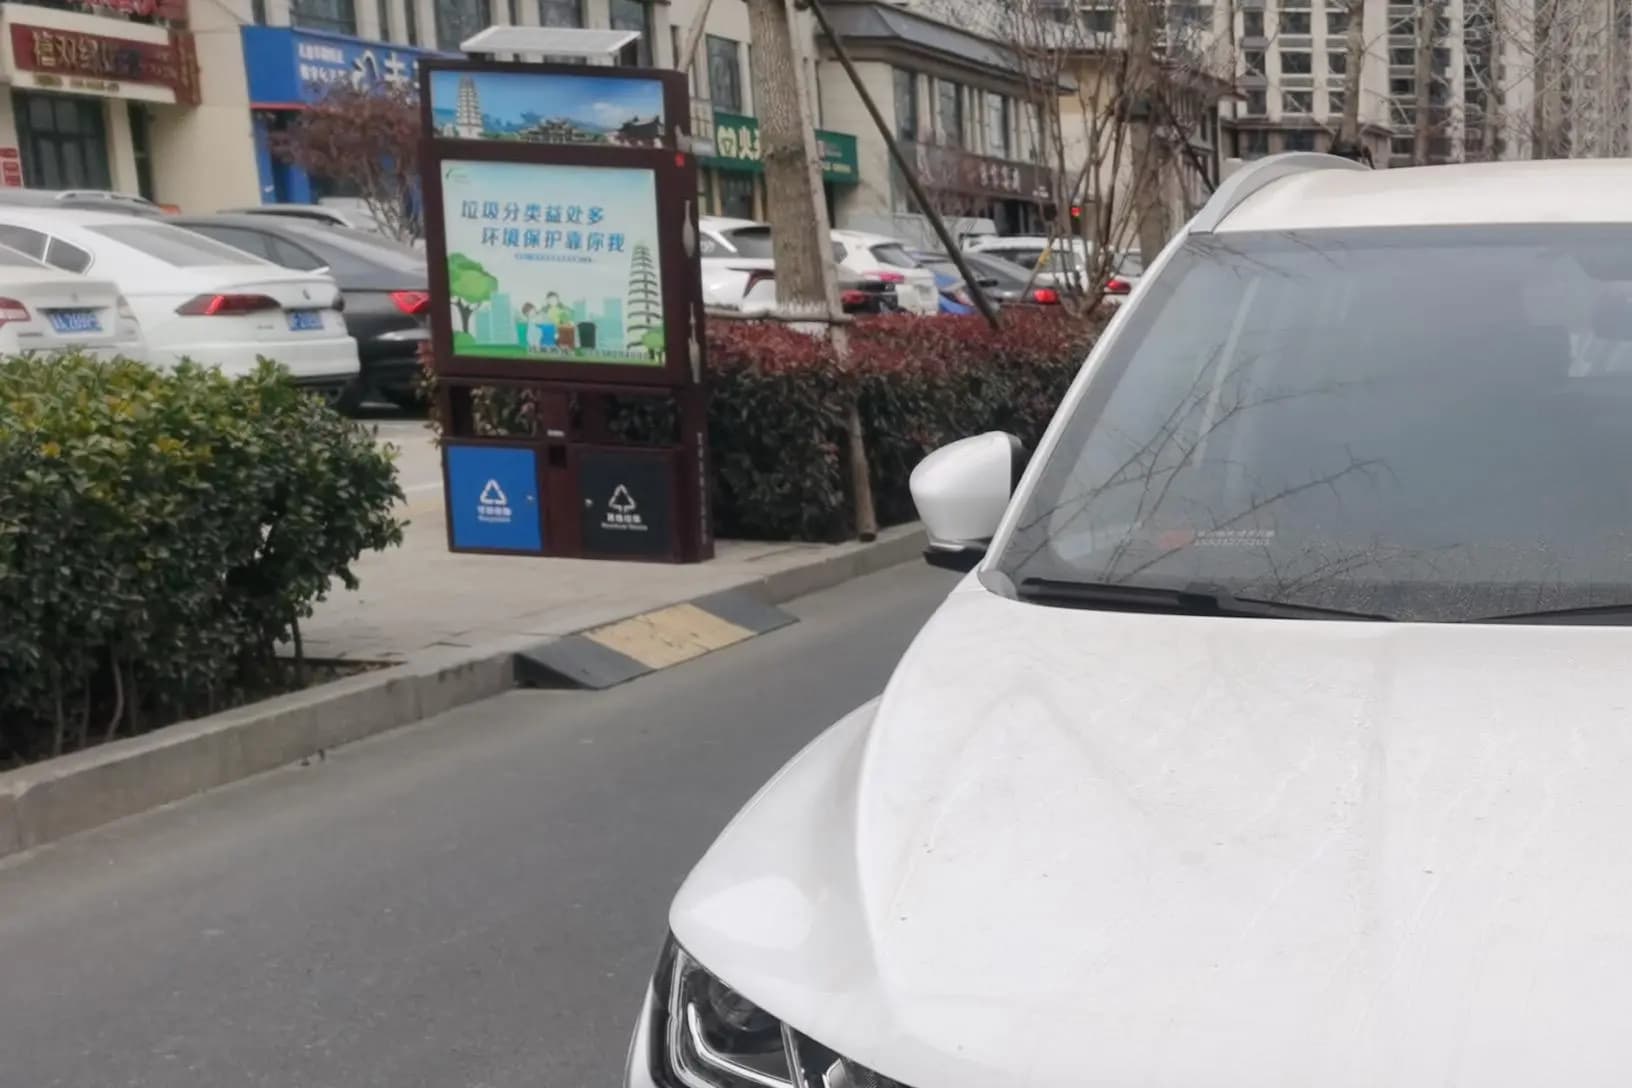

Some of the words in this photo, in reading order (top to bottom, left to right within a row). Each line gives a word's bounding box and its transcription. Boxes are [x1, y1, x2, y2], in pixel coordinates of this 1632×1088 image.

[461, 200, 604, 225] 垃圾分类益处多
[481, 227, 625, 252] 环境保护靠你我
